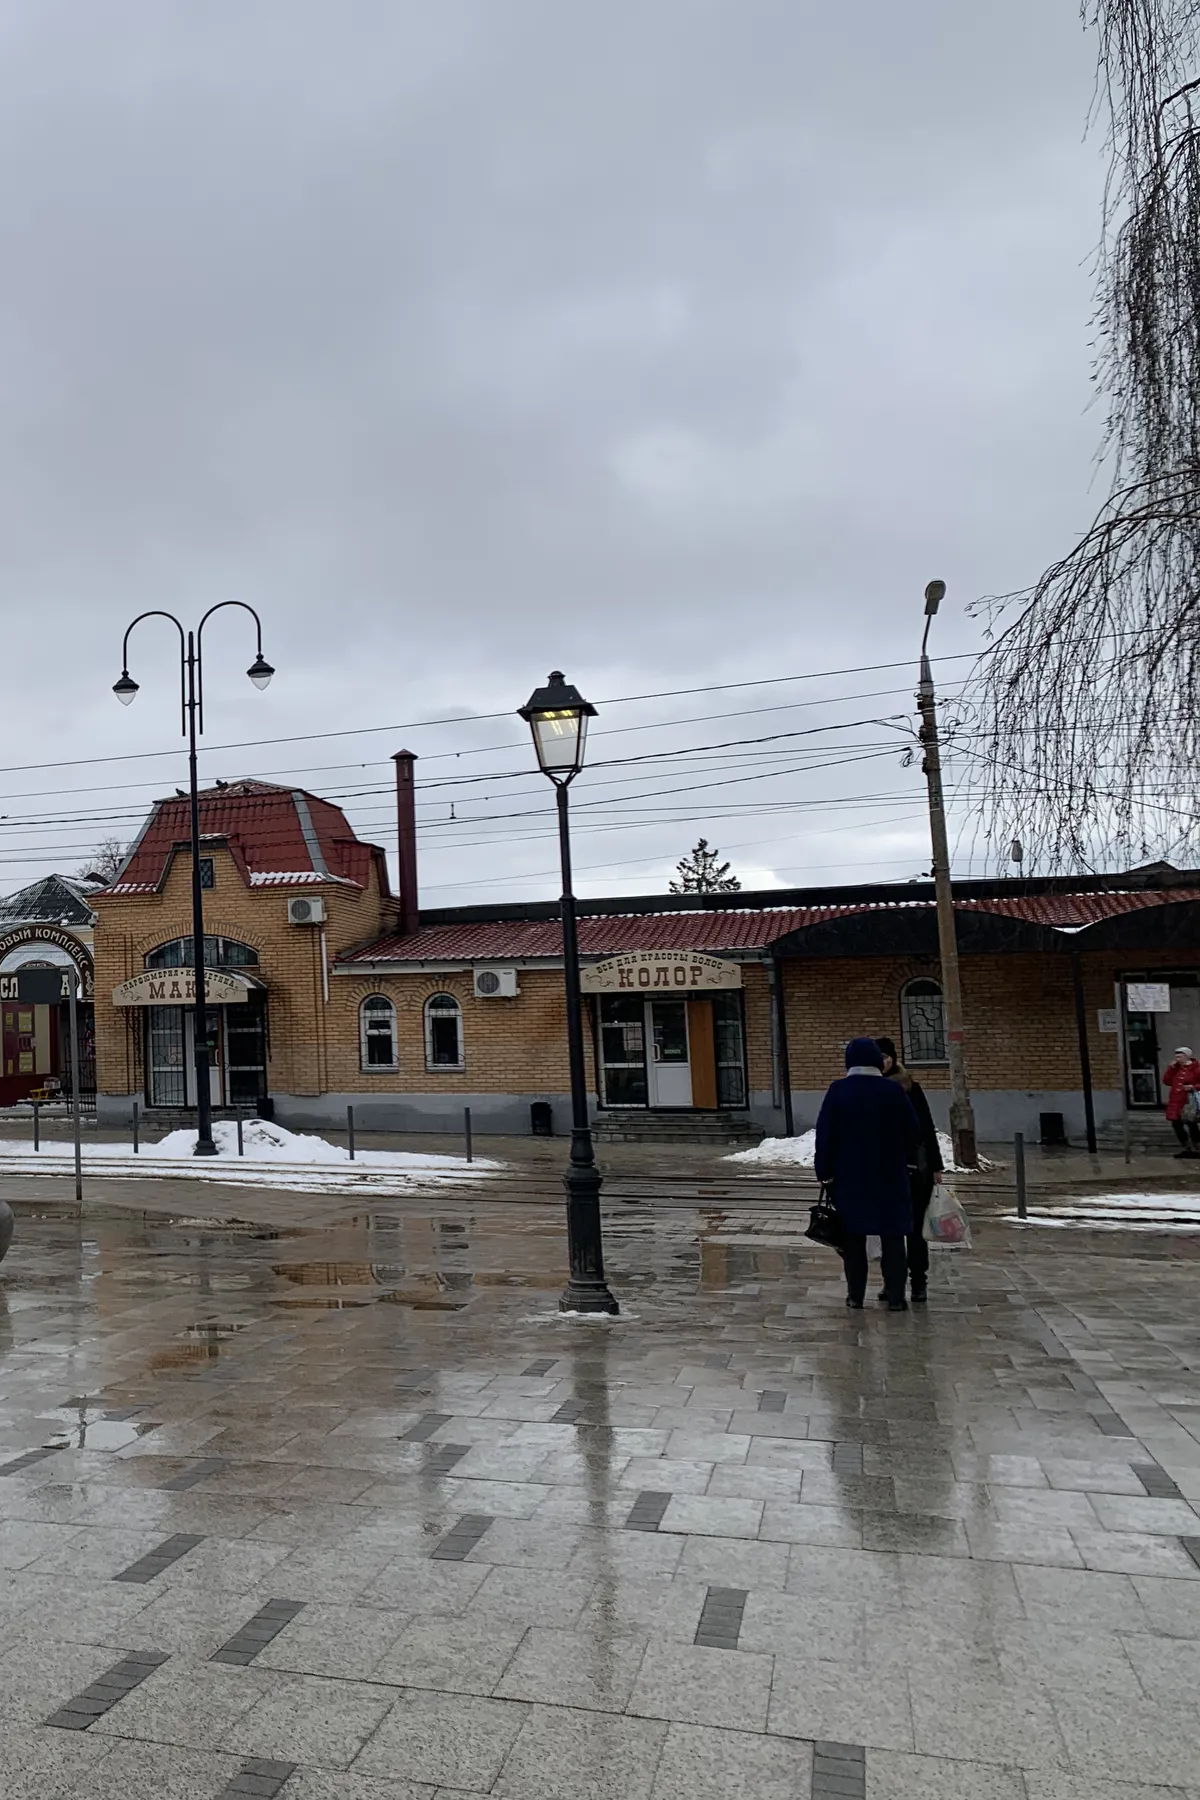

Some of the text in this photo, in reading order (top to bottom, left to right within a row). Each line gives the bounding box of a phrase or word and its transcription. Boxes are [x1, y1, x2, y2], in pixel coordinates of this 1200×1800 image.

[35, 928, 89, 968] КОМПЛЕКС
[596, 953, 723, 974] ВСЕ ДЛЯ КРАСОТЫ ВОЛОС
[123, 969, 179, 991] ПАРФЮМЕРИЯ
[618, 966, 703, 988] КОЛОР
